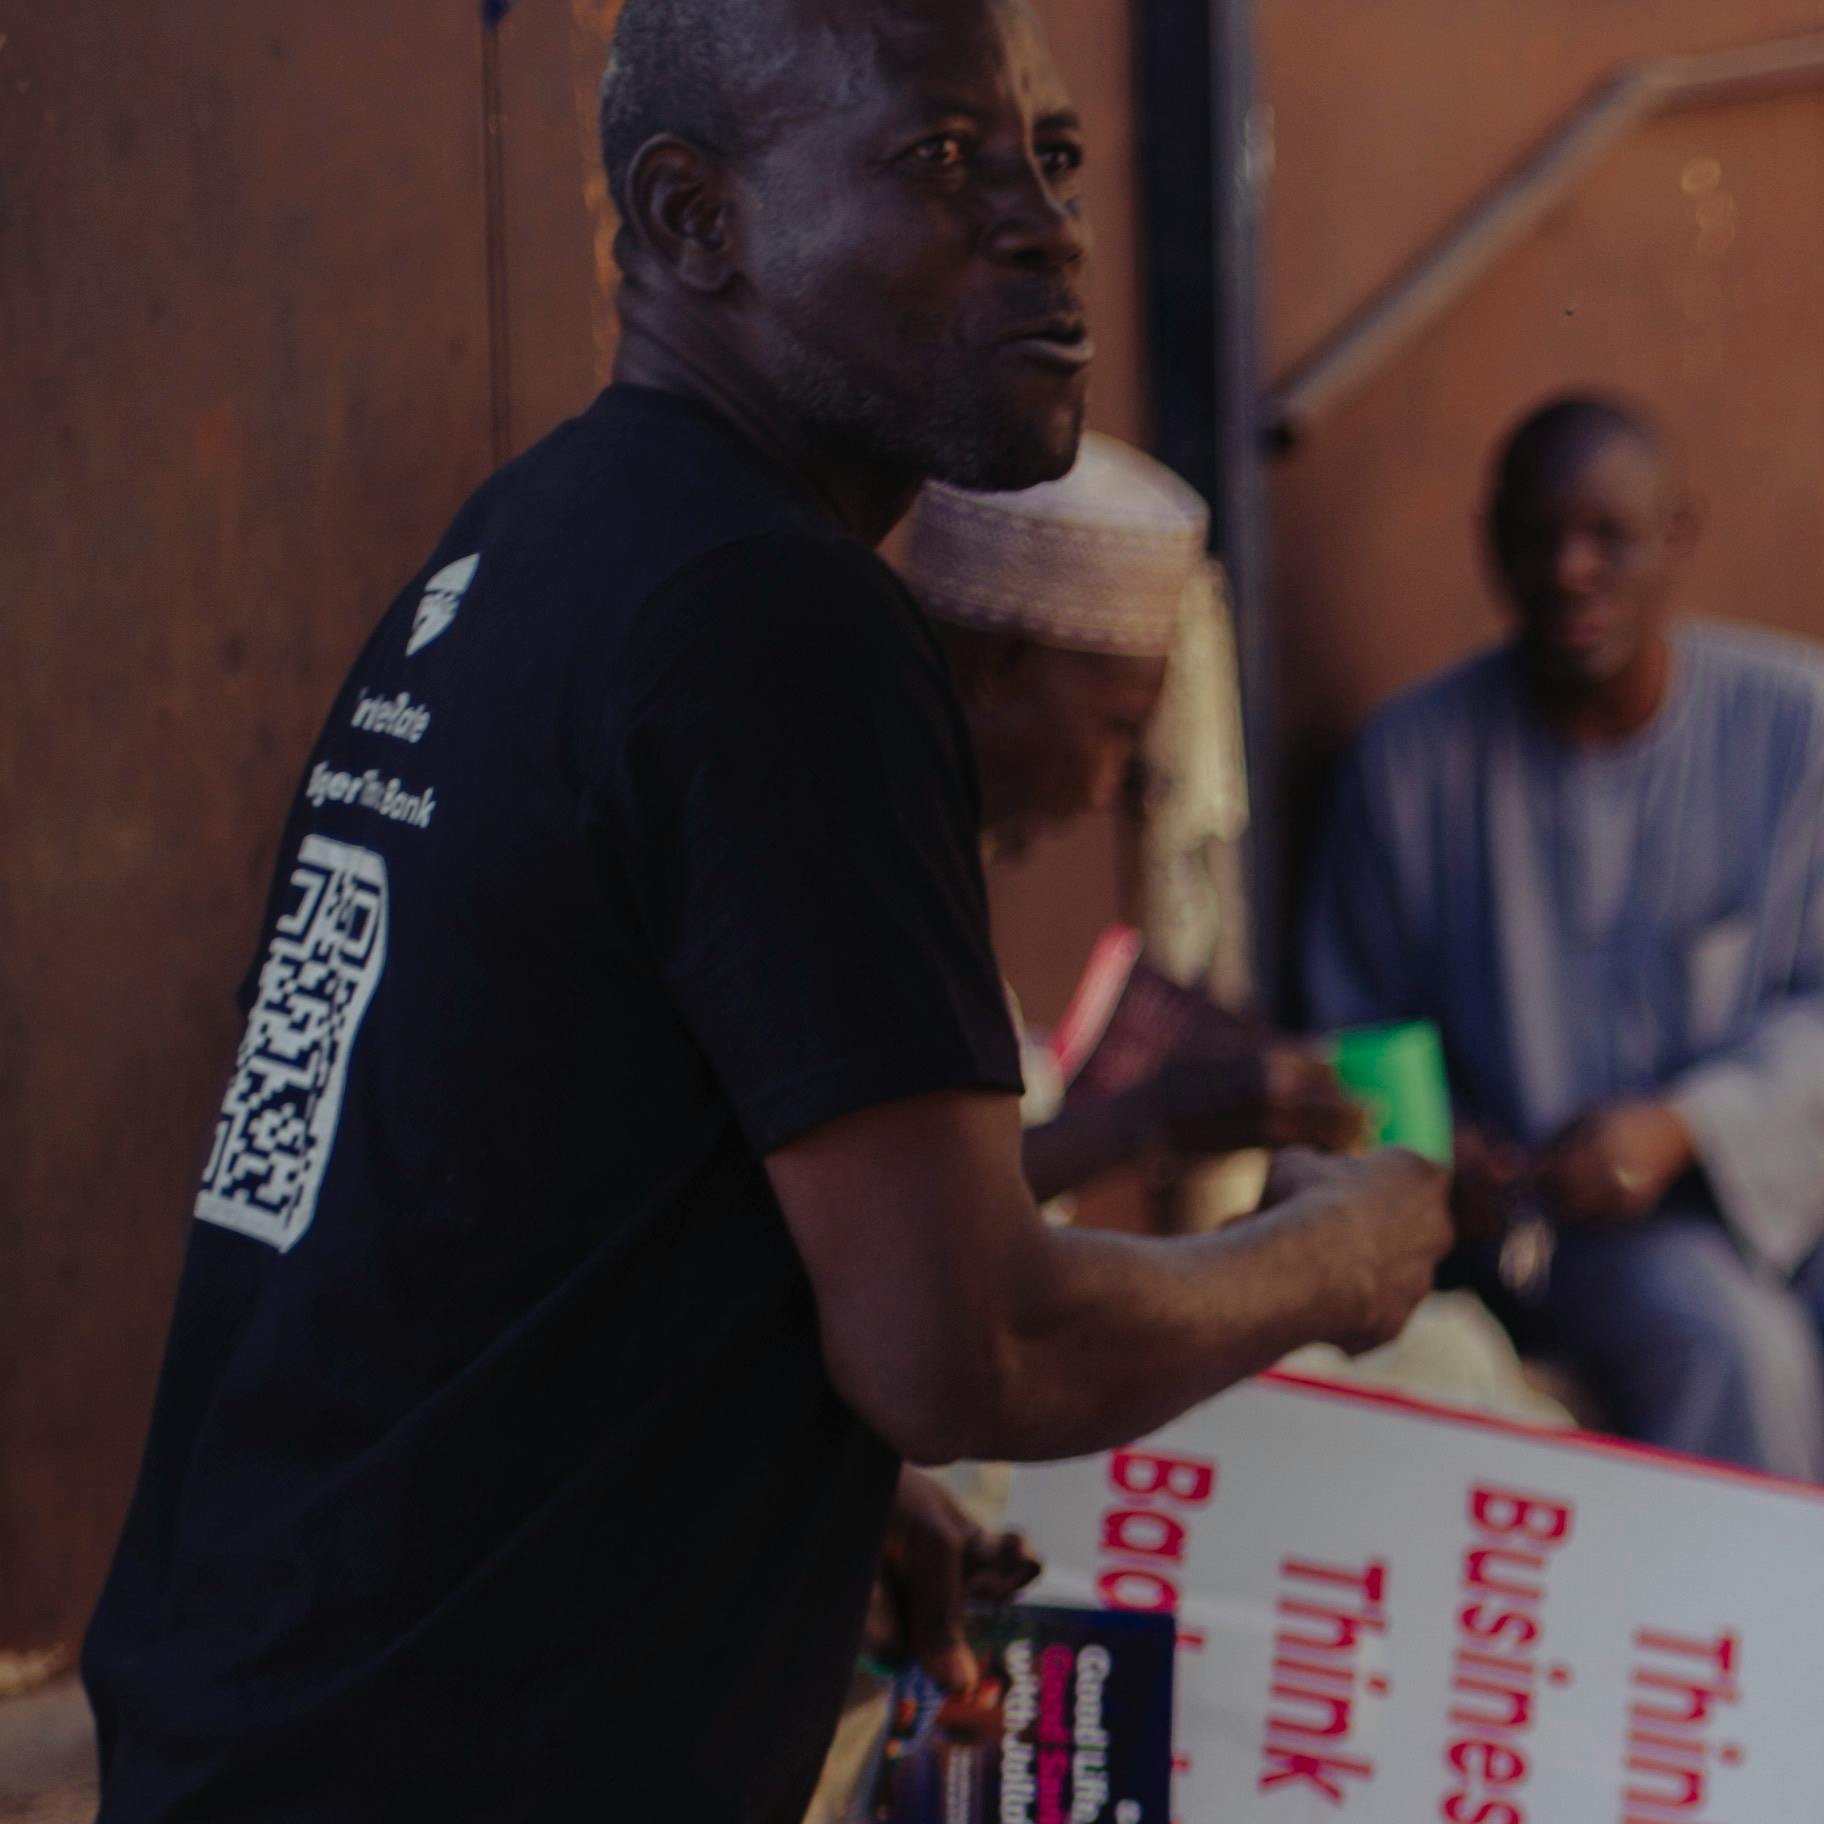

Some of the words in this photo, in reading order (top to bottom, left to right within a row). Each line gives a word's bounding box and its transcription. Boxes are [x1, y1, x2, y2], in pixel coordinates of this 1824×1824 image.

[1004, 1638, 1038, 1732] with
[1039, 1644, 1074, 1744] Good
[1074, 1644, 1111, 1746] Good
[1257, 1556, 1389, 1808] Think
